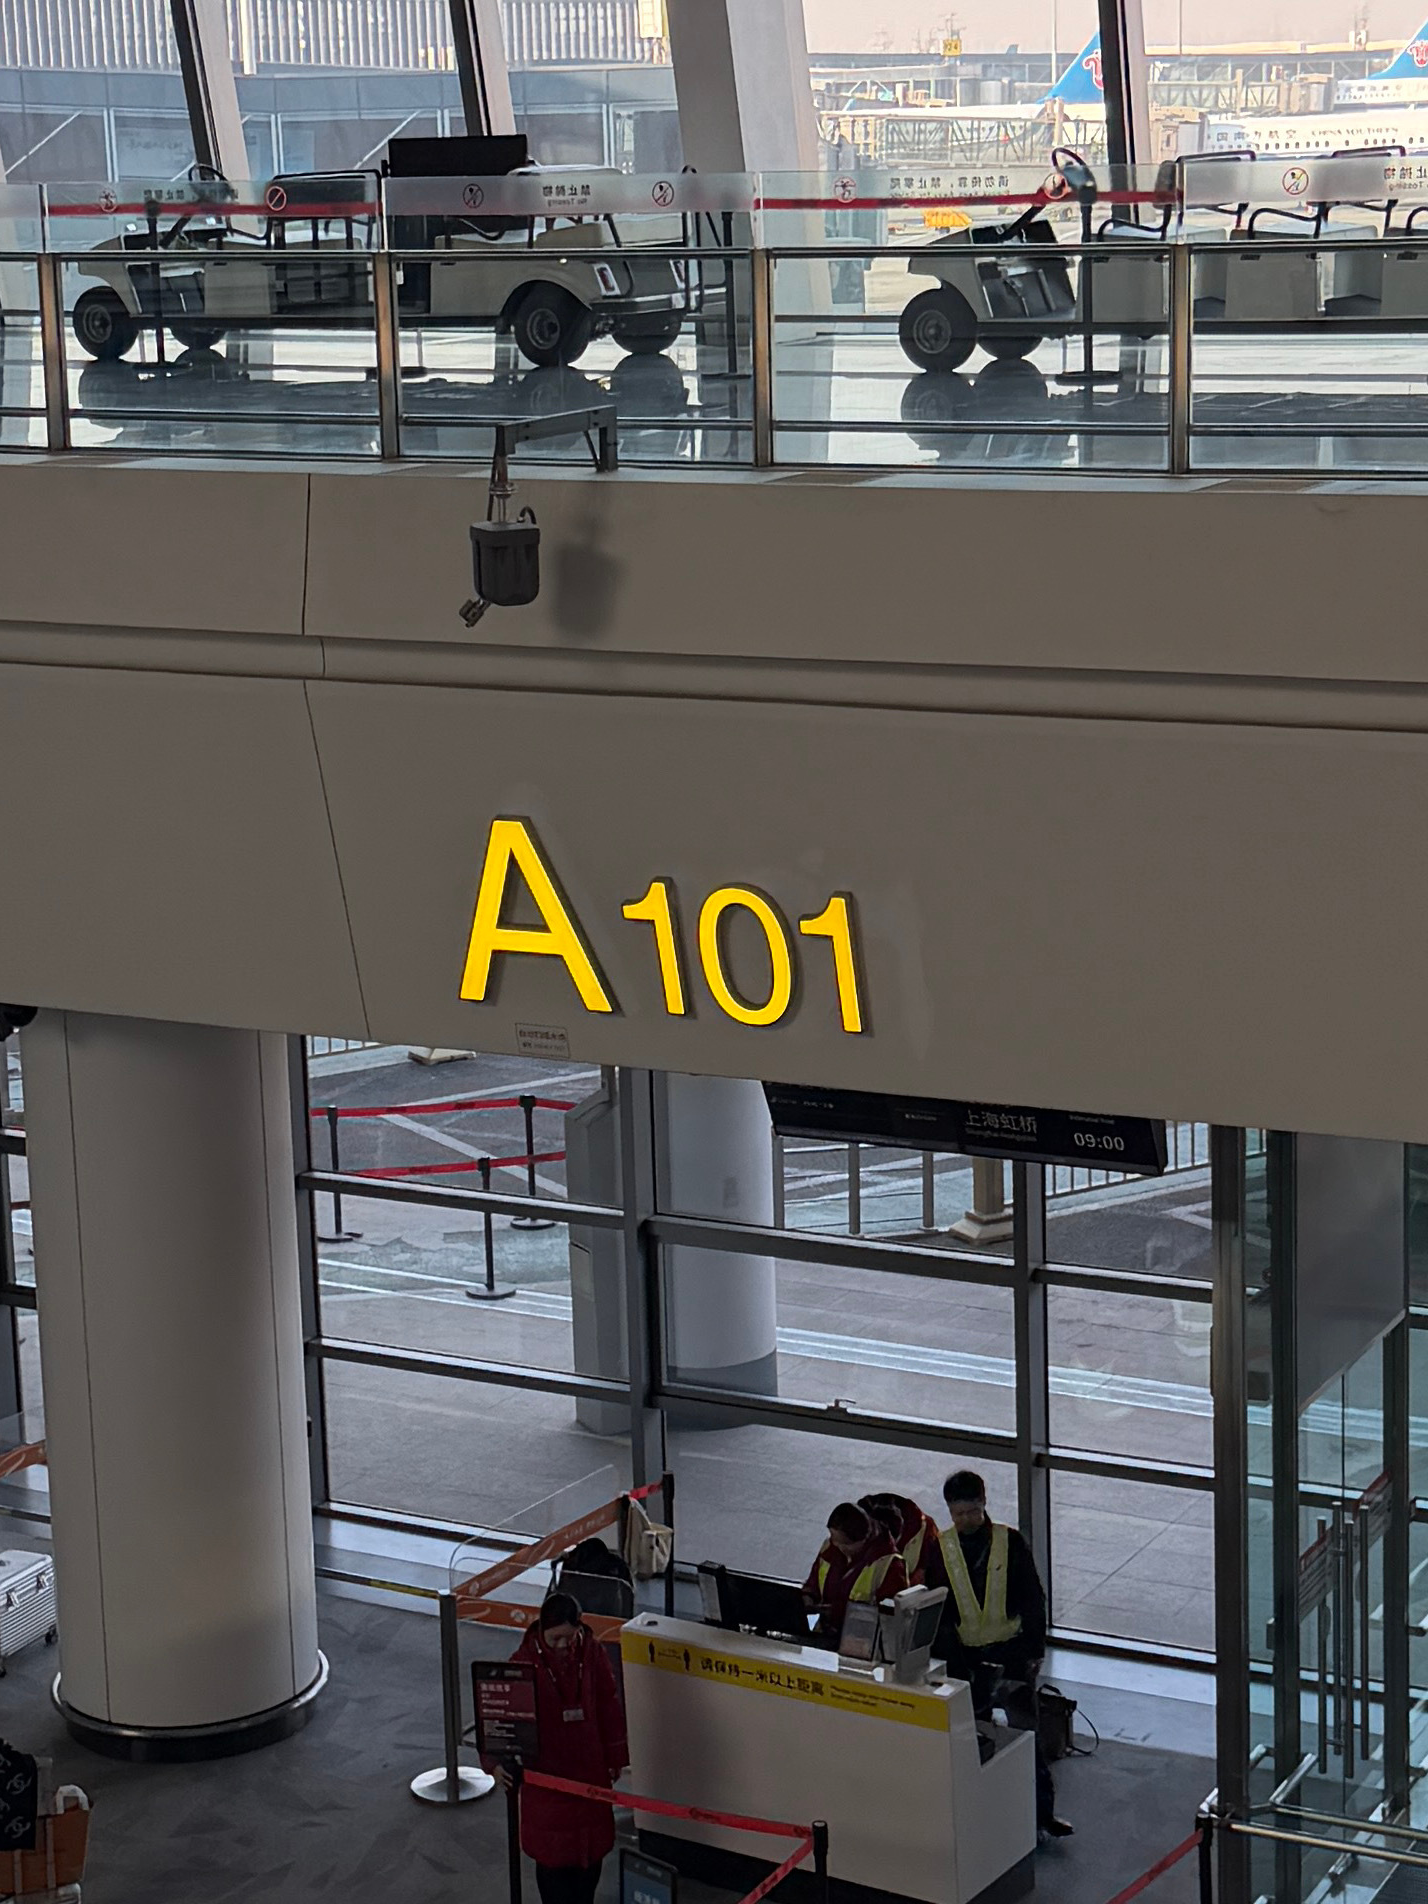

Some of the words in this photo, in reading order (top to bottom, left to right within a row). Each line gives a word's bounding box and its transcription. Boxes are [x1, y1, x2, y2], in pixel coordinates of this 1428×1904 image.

[459, 818, 866, 1035] A101
[965, 1109, 1038, 1134] 上海虹桥
[1073, 1132, 1125, 1151] 09:00
[700, 1656, 824, 1696] 请保持一米以上距离
